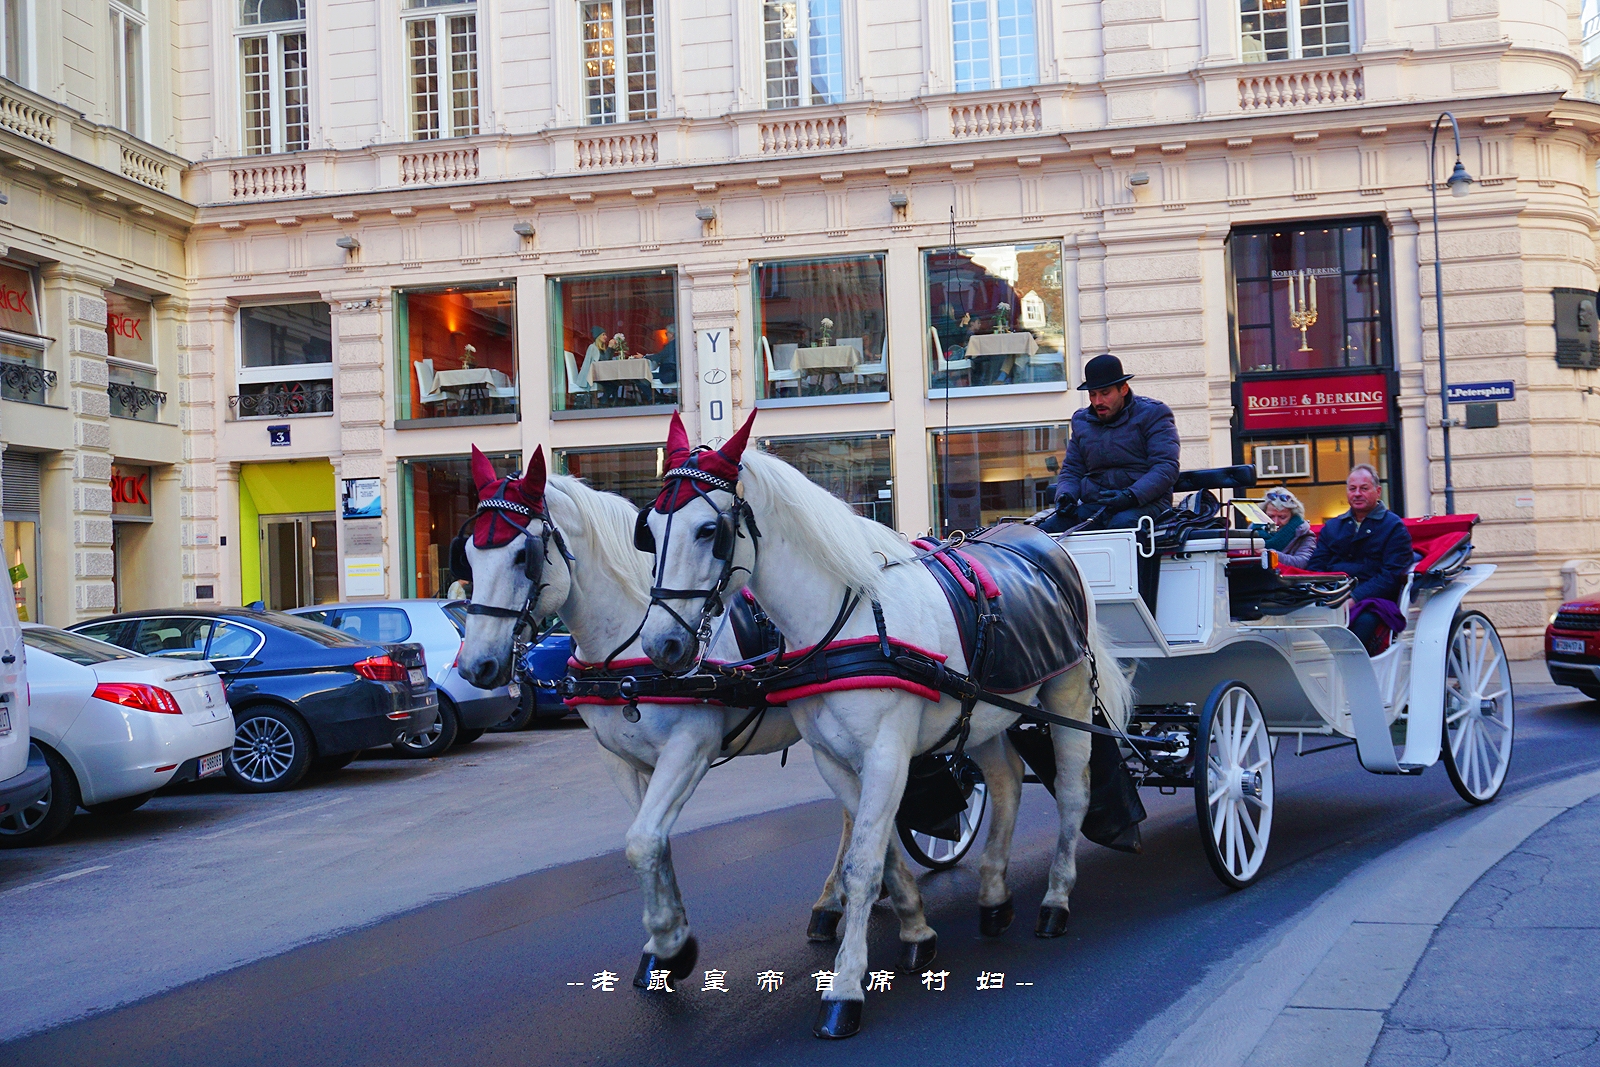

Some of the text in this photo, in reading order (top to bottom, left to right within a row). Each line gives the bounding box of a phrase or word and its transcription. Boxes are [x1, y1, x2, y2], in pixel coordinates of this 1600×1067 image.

[1248, 390, 1383, 408] ROBBE & BERKING
[1294, 407, 1338, 416] SILBER
[276, 431, 285, 442] 3
